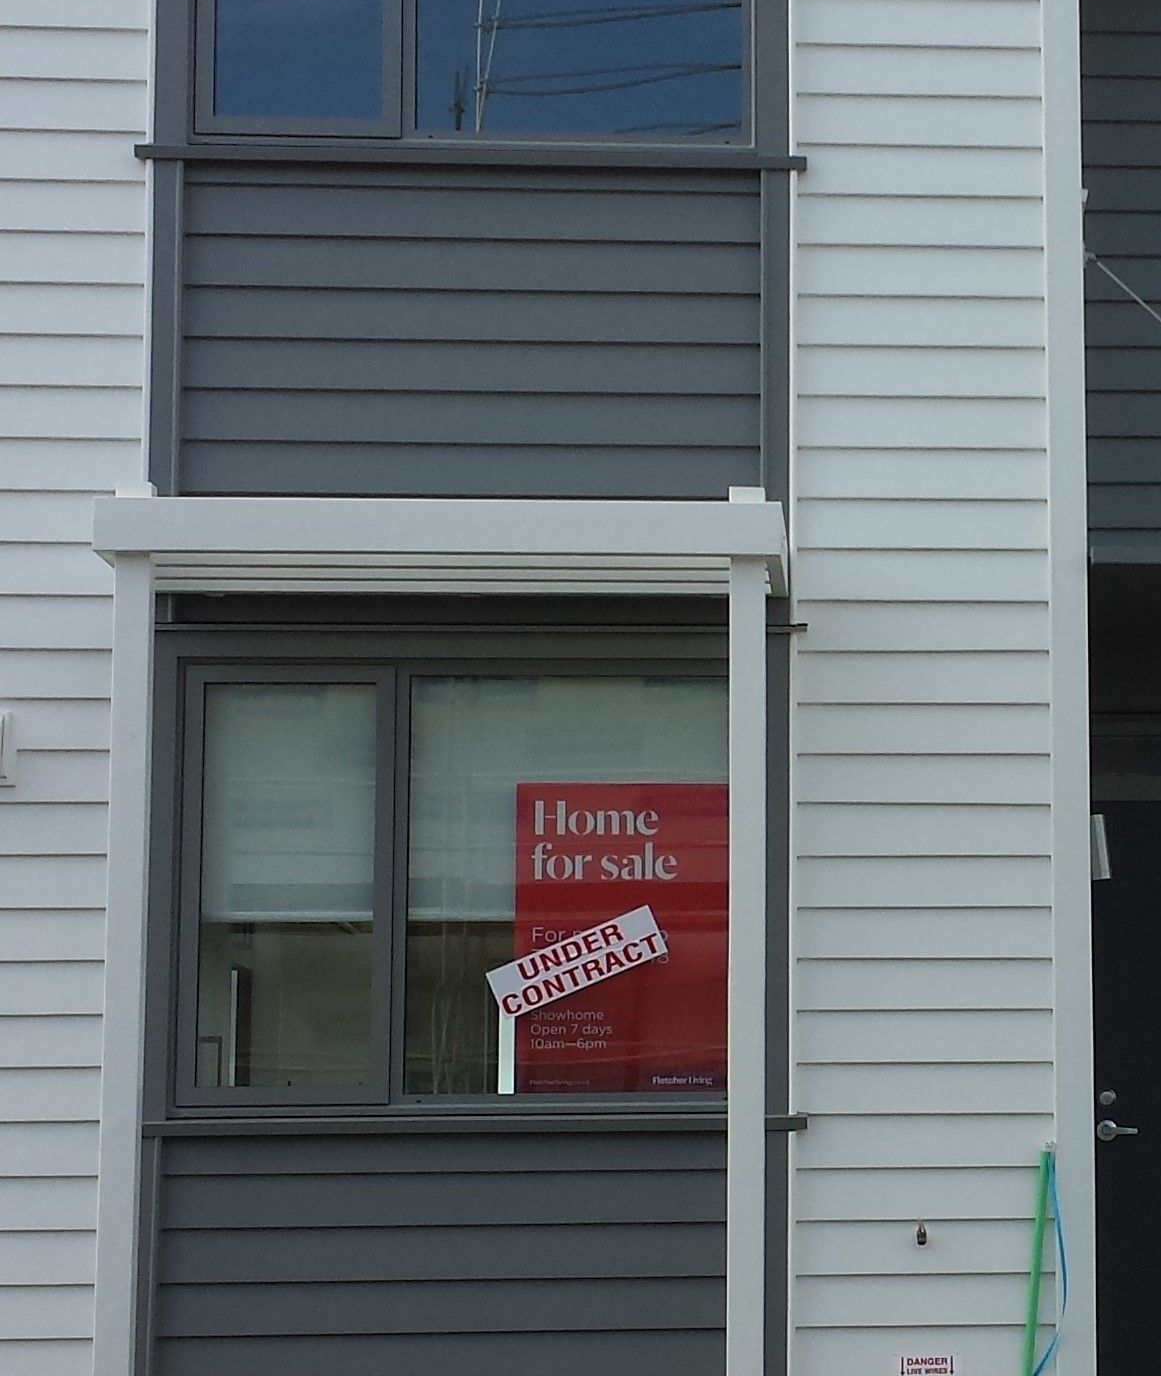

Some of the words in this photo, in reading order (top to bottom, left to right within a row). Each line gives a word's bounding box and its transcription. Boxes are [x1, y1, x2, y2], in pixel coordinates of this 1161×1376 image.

[534, 799, 659, 836] Home
[531, 842, 593, 881] for
[600, 842, 678, 881] sale
[531, 926, 566, 942] For
[516, 922, 624, 981] UNDER
[501, 932, 660, 1017] CONTRACT
[530, 1009, 604, 1021] Showhome
[530, 1024, 567, 1036] Open
[570, 1024, 579, 1035] 7
[582, 1023, 613, 1036] days
[906, 1357, 948, 1366] DANGER
